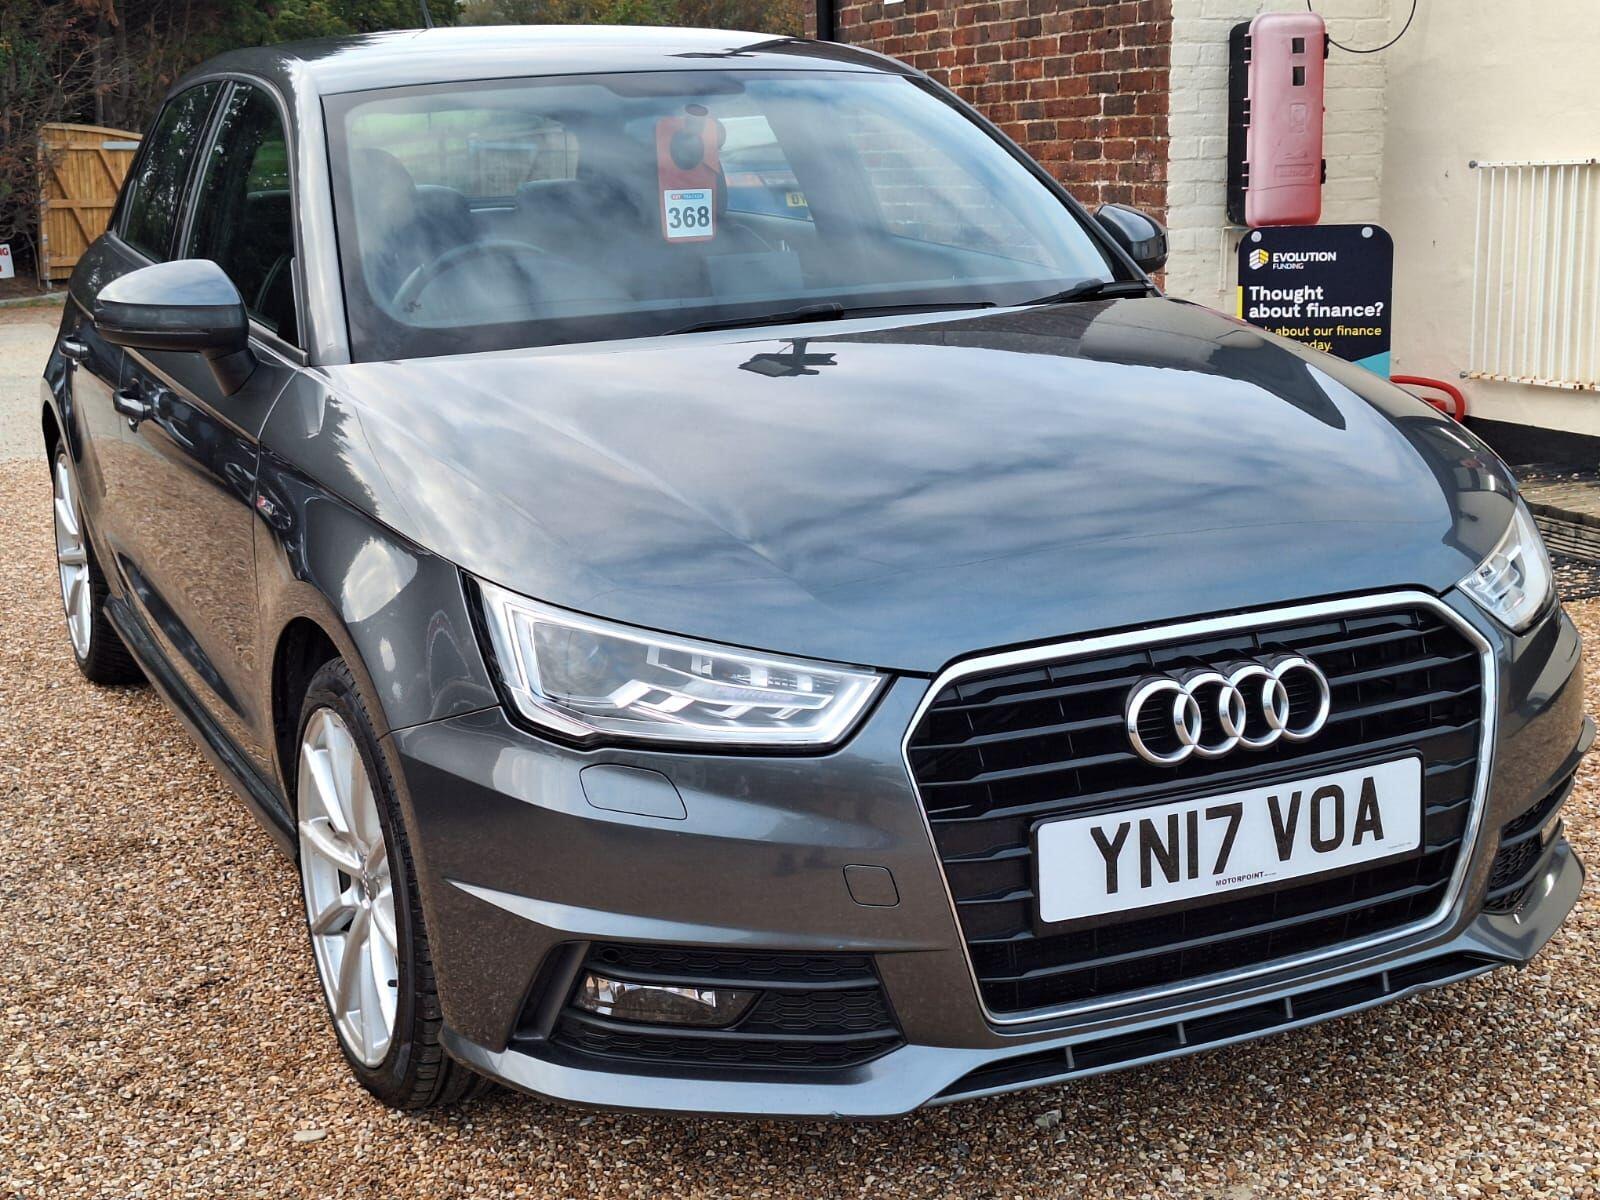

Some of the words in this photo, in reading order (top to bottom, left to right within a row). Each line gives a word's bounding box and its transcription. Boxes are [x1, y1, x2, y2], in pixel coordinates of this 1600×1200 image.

[668, 206, 710, 228] 368
[1272, 252, 1337, 262] EVOLUTION
[1249, 286, 1324, 303] Thought
[1249, 304, 1301, 318] about
[1306, 302, 1384, 317] finance?
[1275, 326, 1310, 336] about
[1313, 328, 1333, 336] our
[1336, 325, 1382, 336] finance
[1302, 339, 1333, 352] day.
[1090, 802, 1243, 894] YN17
[1267, 777, 1385, 861] VOA
[1215, 871, 1264, 887] MOTORPOINT
